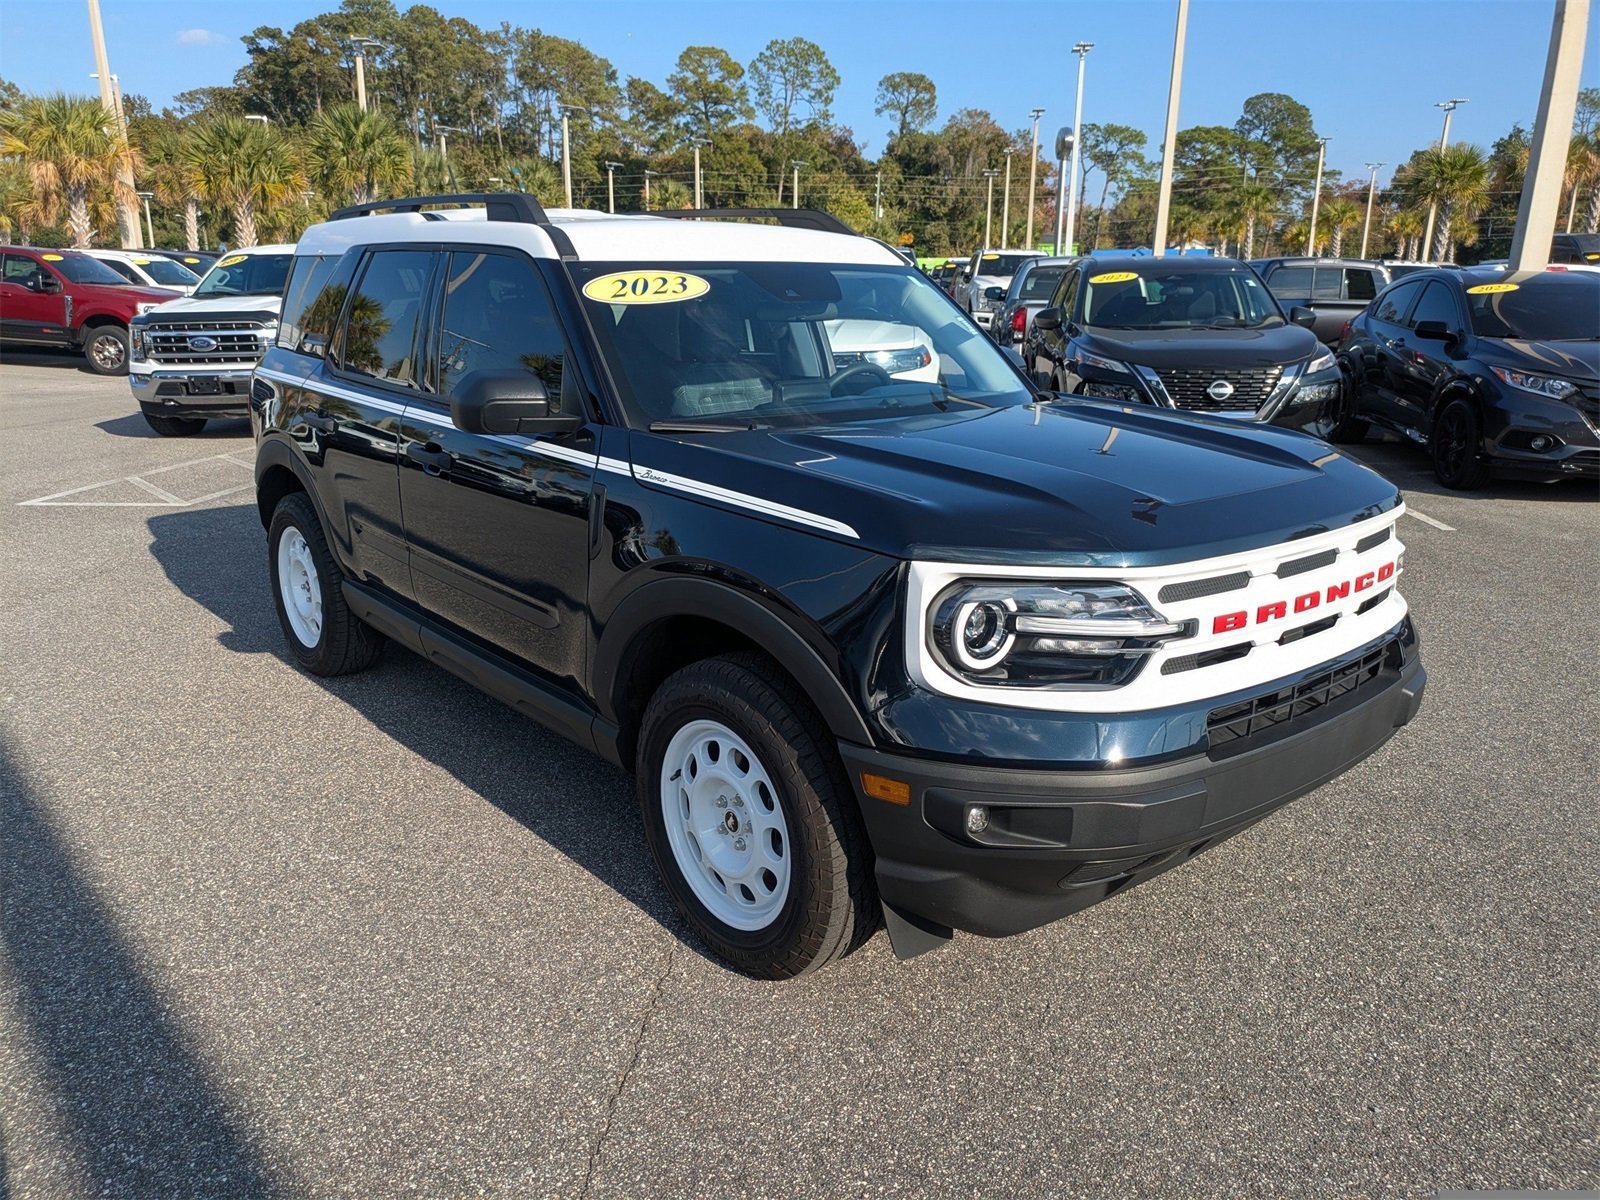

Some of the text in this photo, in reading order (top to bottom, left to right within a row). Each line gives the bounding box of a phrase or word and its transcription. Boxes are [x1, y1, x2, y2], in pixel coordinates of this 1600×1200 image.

[610, 276, 687, 298] 2023
[640, 469, 668, 482] Bronco
[1212, 561, 1395, 634] BRONCO
